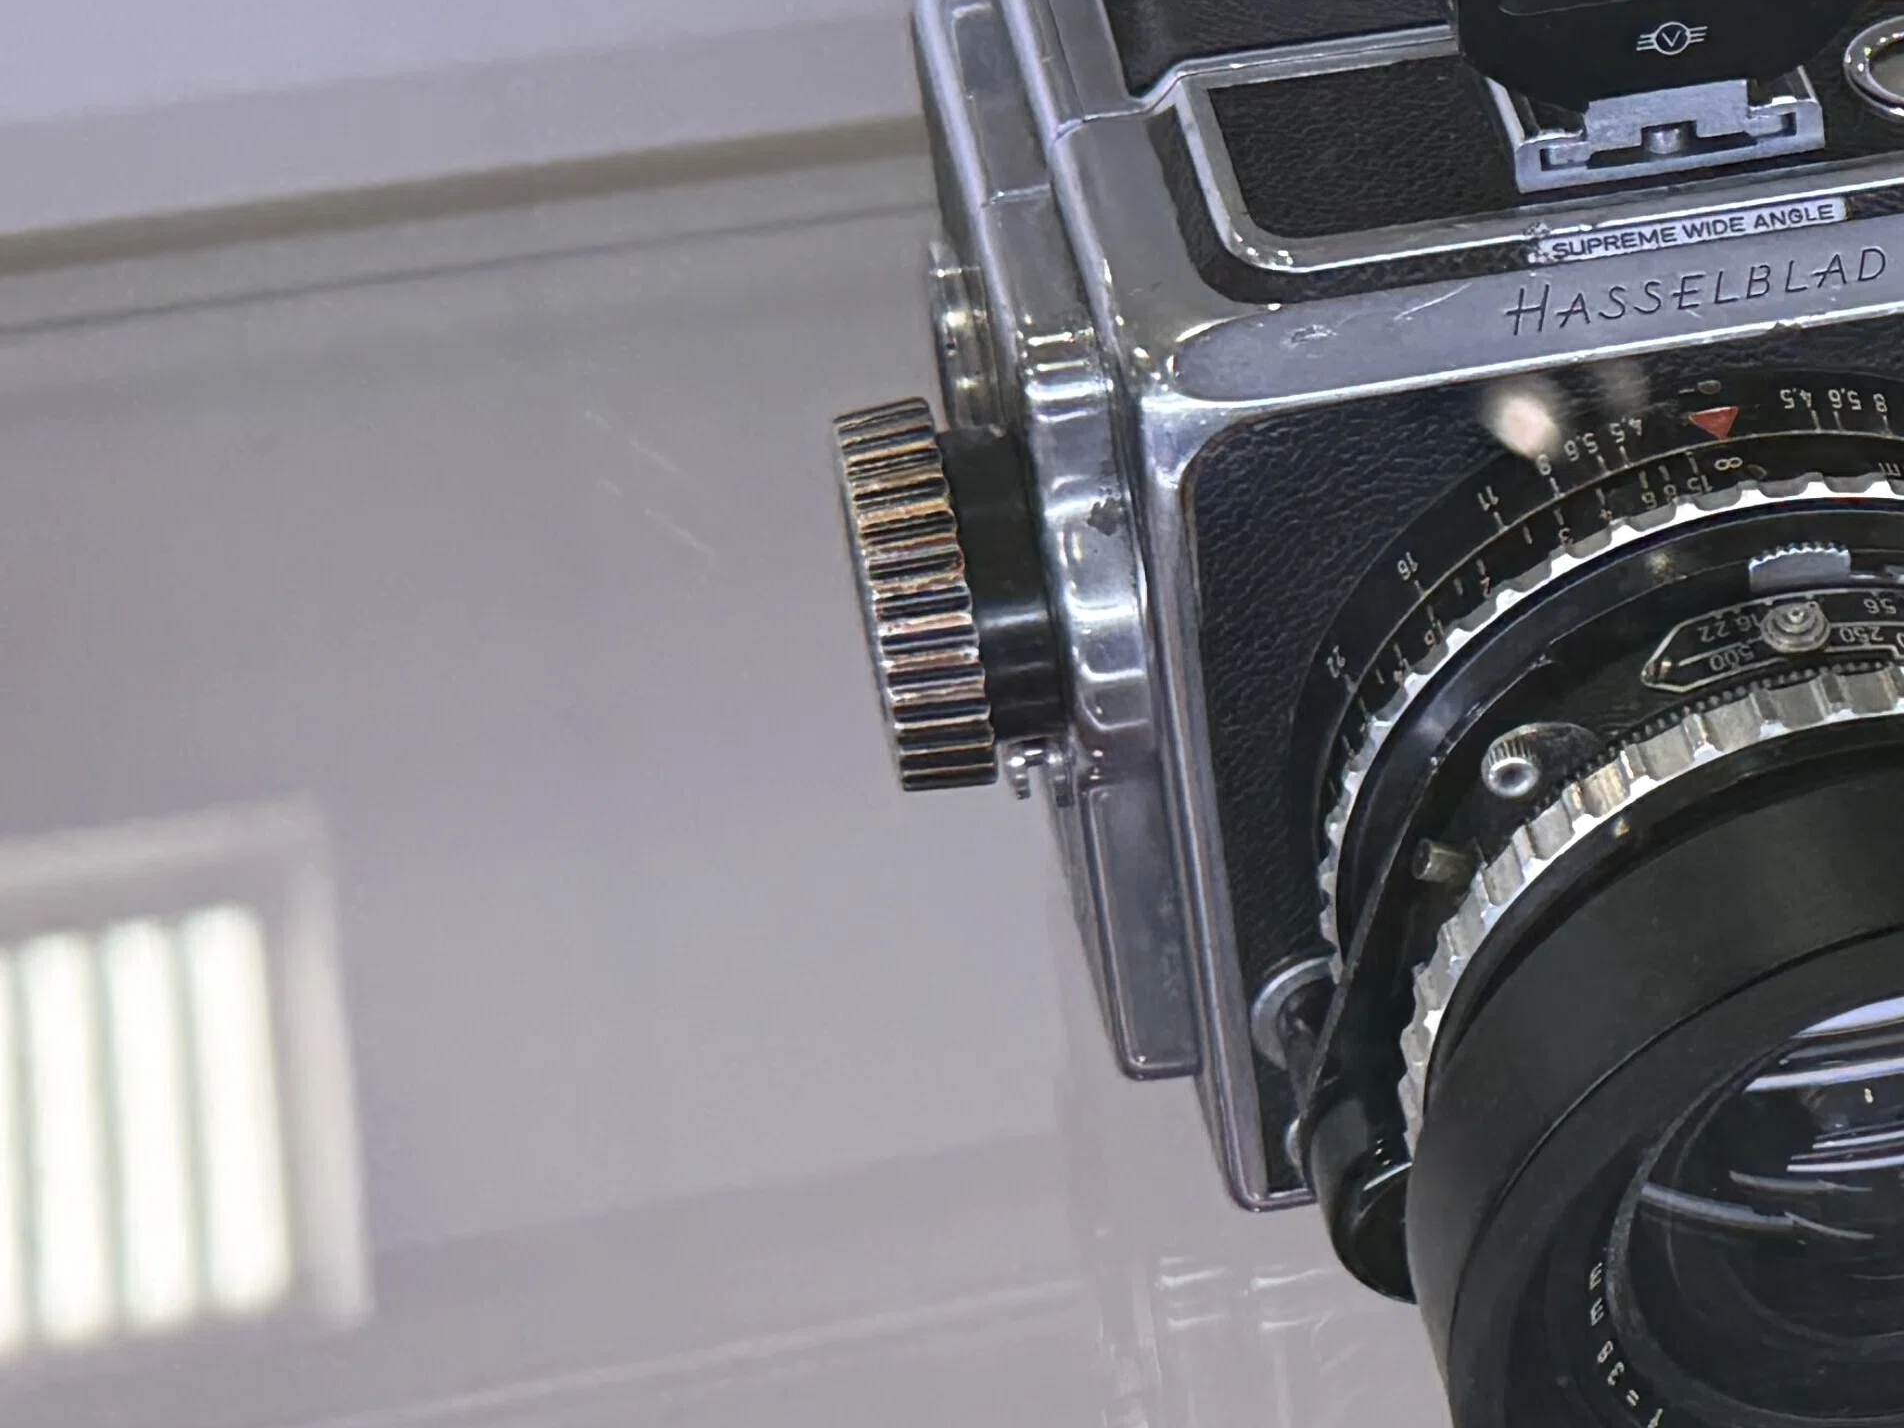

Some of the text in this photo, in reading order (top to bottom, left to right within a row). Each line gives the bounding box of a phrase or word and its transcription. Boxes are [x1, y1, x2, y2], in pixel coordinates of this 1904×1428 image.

[1551, 202, 1836, 259] SUPREME WIDE ANGLE
[1505, 247, 1887, 336] HASSELBLAD
[1873, 393, 1888, 413] 8
[1839, 625, 1886, 645] 250
[1709, 644, 1755, 673] 500
